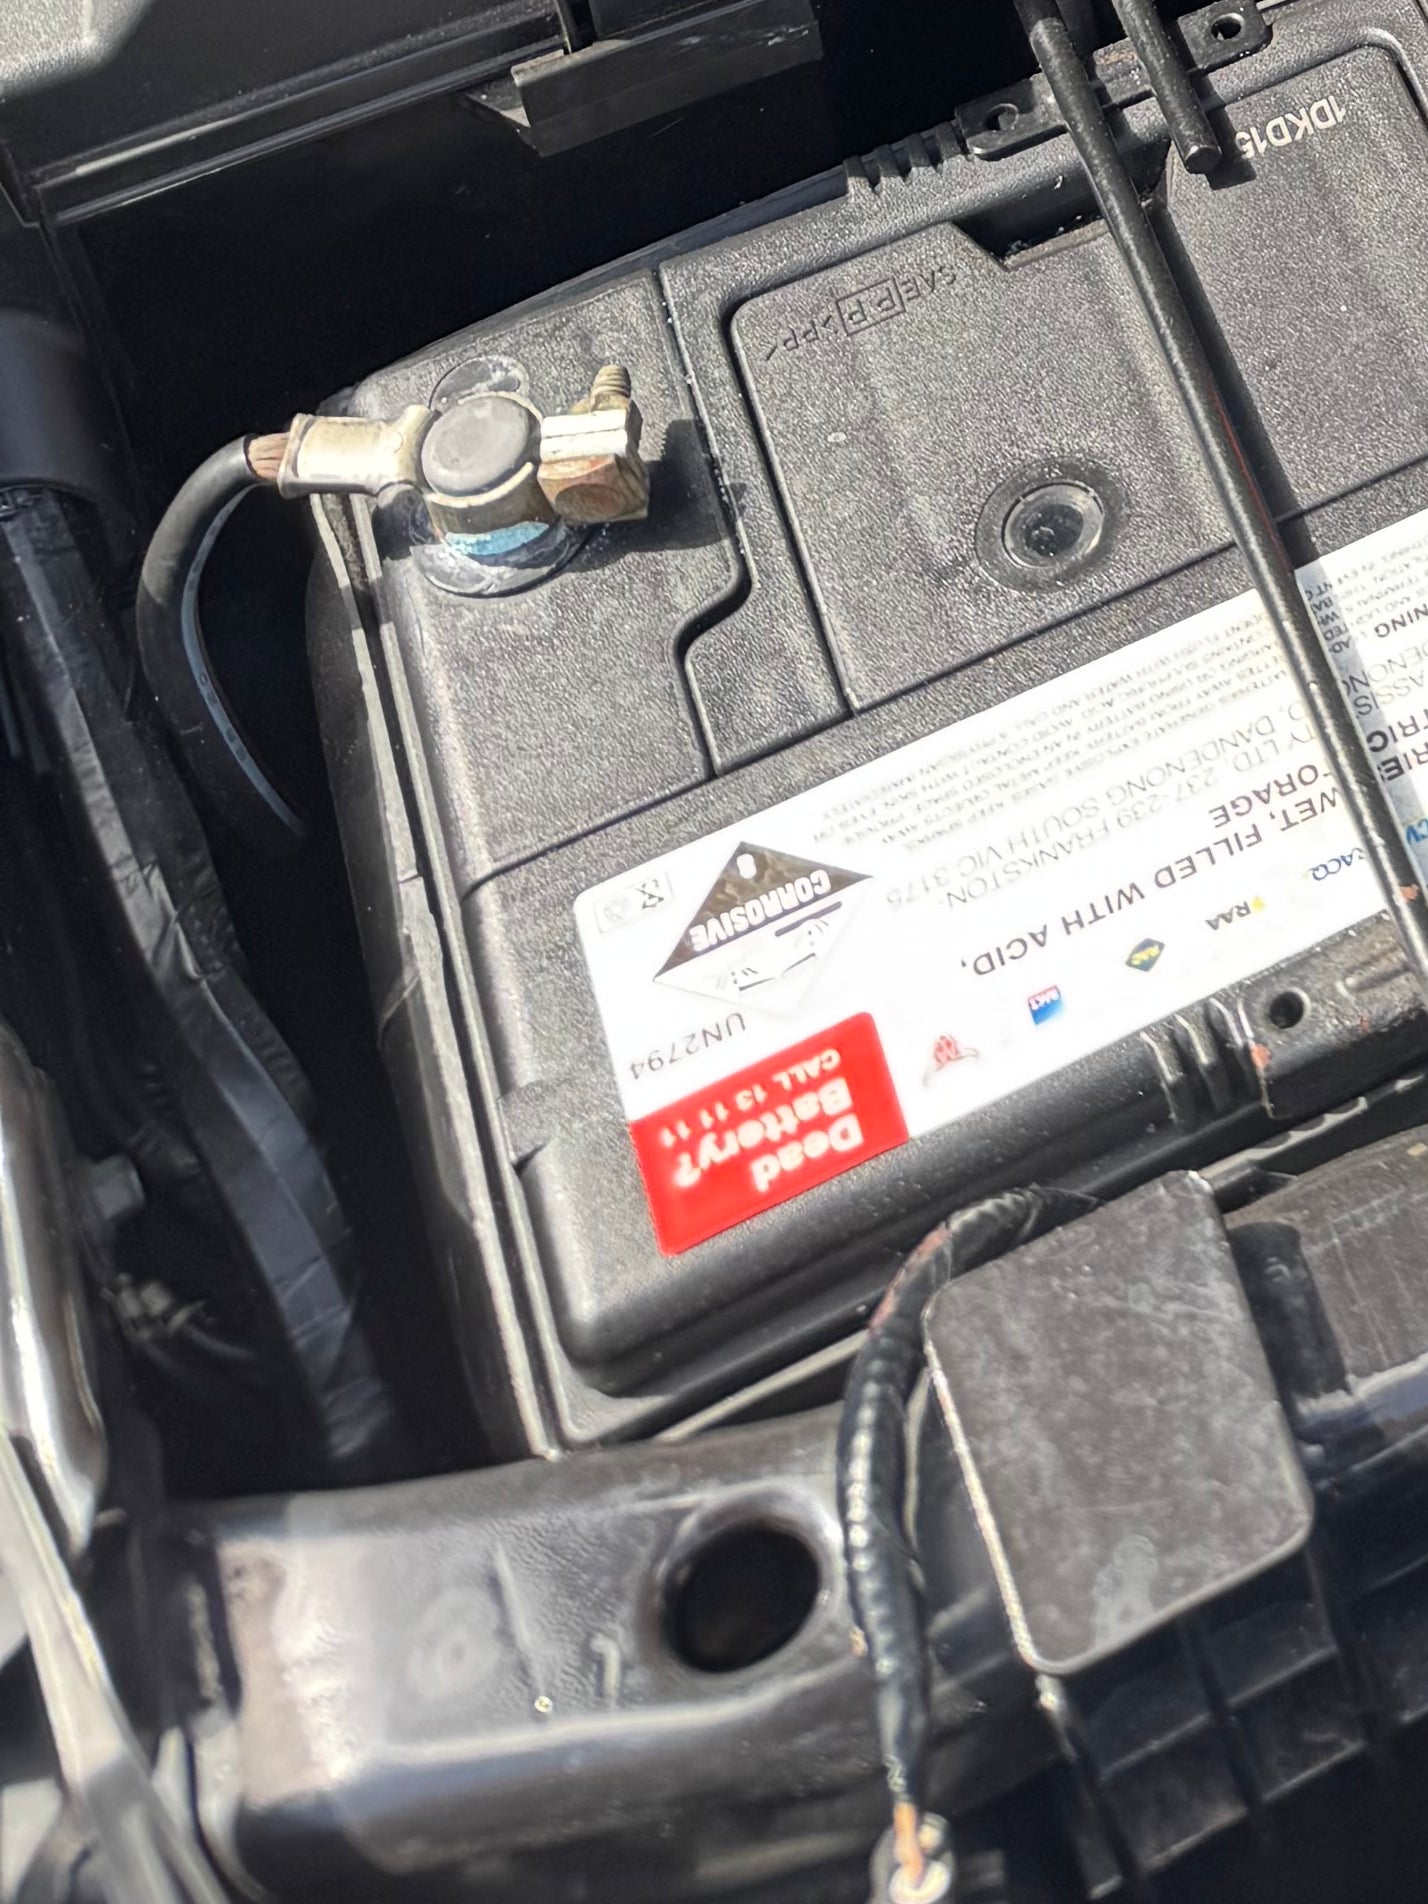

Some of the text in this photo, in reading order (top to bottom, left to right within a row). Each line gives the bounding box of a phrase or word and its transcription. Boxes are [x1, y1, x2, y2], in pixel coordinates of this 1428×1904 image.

[1102, 711, 1276, 810] DANDENONG
[1283, 720, 1318, 749] TY
[1004, 793, 1102, 856] SOUTH
[1207, 755, 1332, 830] ORAGE
[882, 863, 951, 913] 3175
[954, 841, 1002, 879] VIC
[1154, 823, 1262, 888] FILLED
[687, 865, 834, 954] CORROSIVE
[1061, 882, 1144, 934] WITH
[1205, 901, 1251, 930] RAA
[961, 924, 1046, 975] ACID,
[630, 1012, 745, 1079] UN2794
[658, 1043, 843, 1149] CALL 13 11 11
[666, 1068, 854, 1192] Battery?
[746, 1109, 865, 1195] Dead
